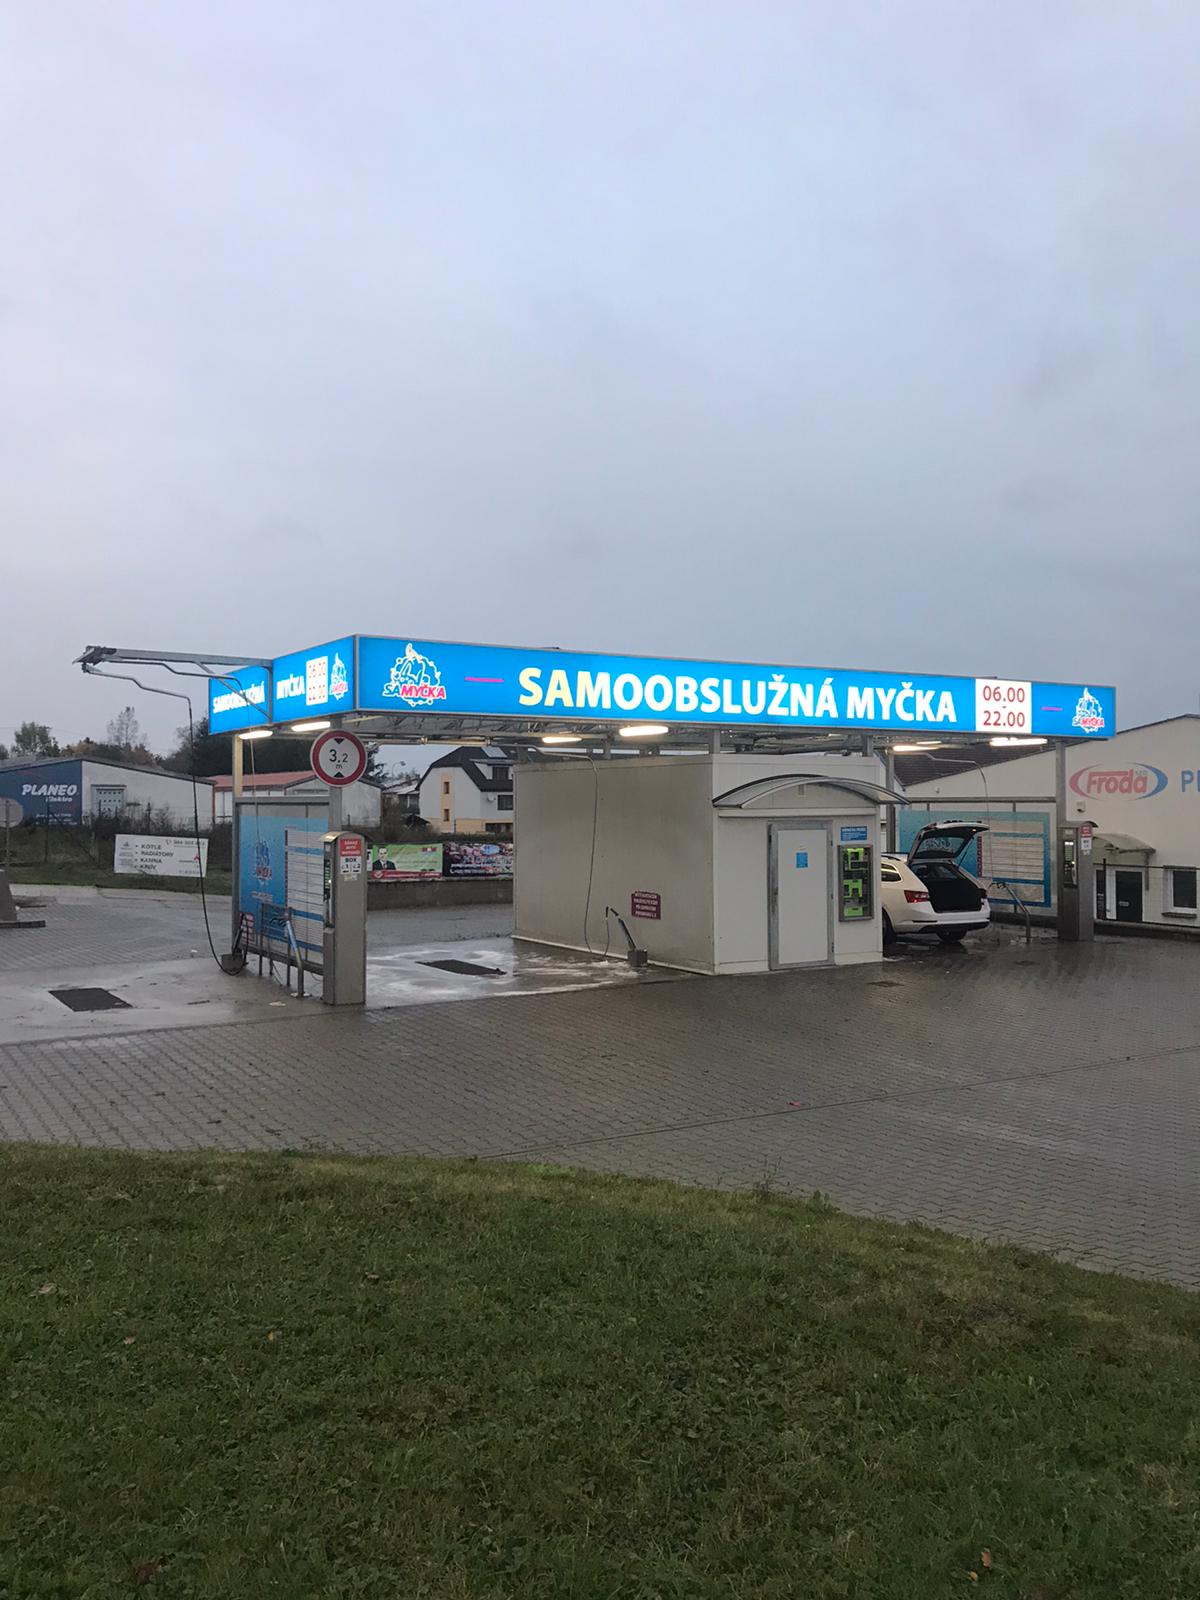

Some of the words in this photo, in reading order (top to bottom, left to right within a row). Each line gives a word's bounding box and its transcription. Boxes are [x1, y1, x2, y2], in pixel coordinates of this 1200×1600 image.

[383, 683, 446, 699] SAMYČKA
[518, 667, 838, 718] SAMOOBSLUŽNÁ
[847, 681, 957, 722] MYČKA
[982, 685, 1025, 703] 06.00
[982, 710, 1025, 727] 22.00
[329, 749, 348, 763] 3.2
[22, 784, 78, 796] PLANEO
[1087, 769, 1147, 794] Froda
[1181, 770, 1200, 792] P
